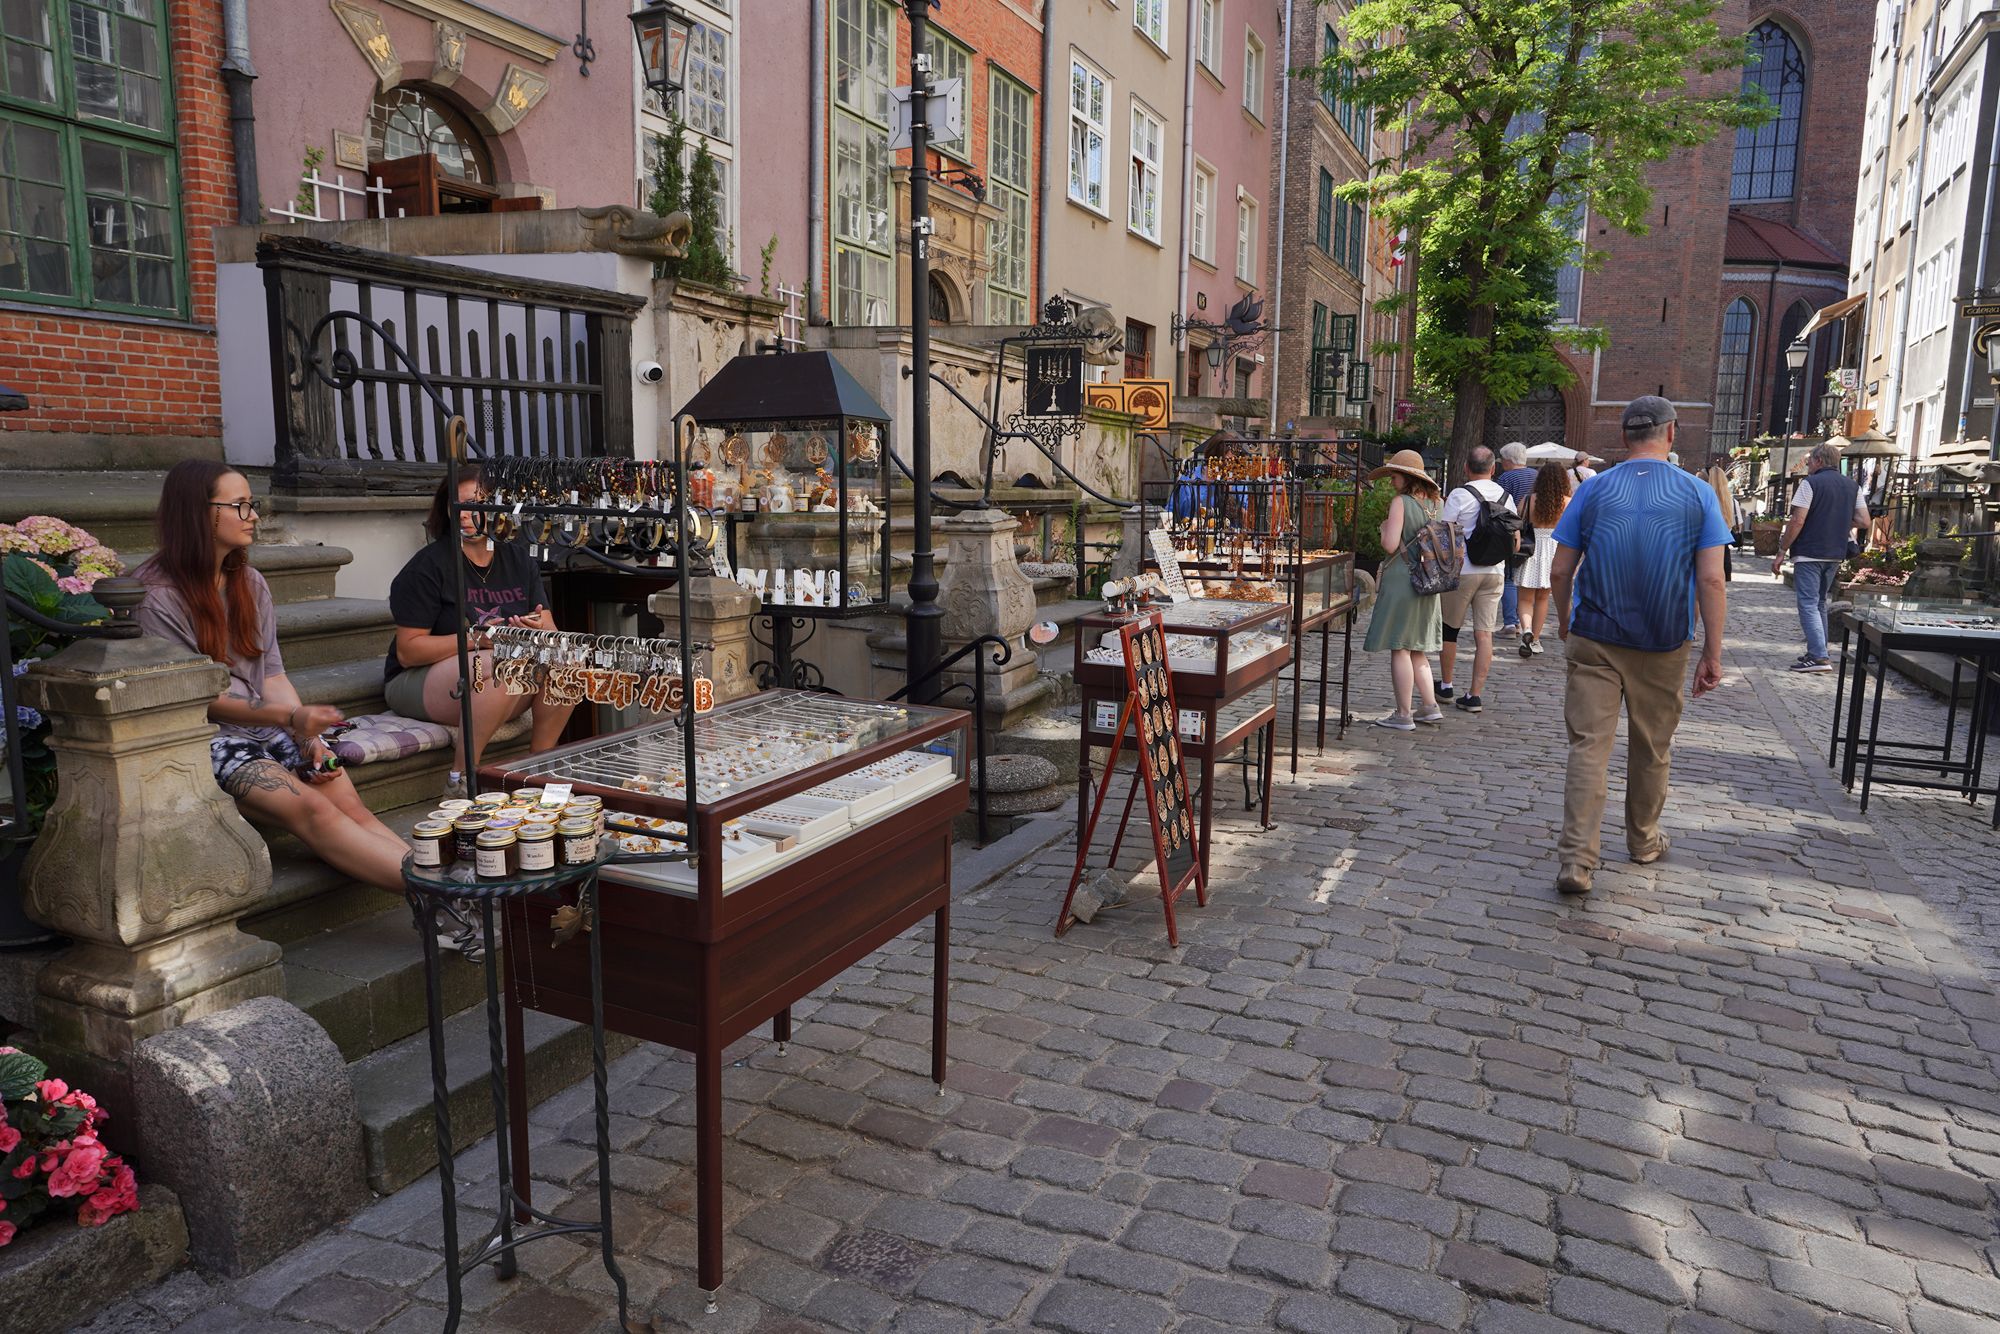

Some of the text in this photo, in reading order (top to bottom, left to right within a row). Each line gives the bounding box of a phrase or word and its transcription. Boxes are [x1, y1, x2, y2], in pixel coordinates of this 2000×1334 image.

[448, 39, 461, 63] 7
[642, 27, 663, 70] 7
[670, 27, 688, 70] 7
[694, 678, 715, 714] B
